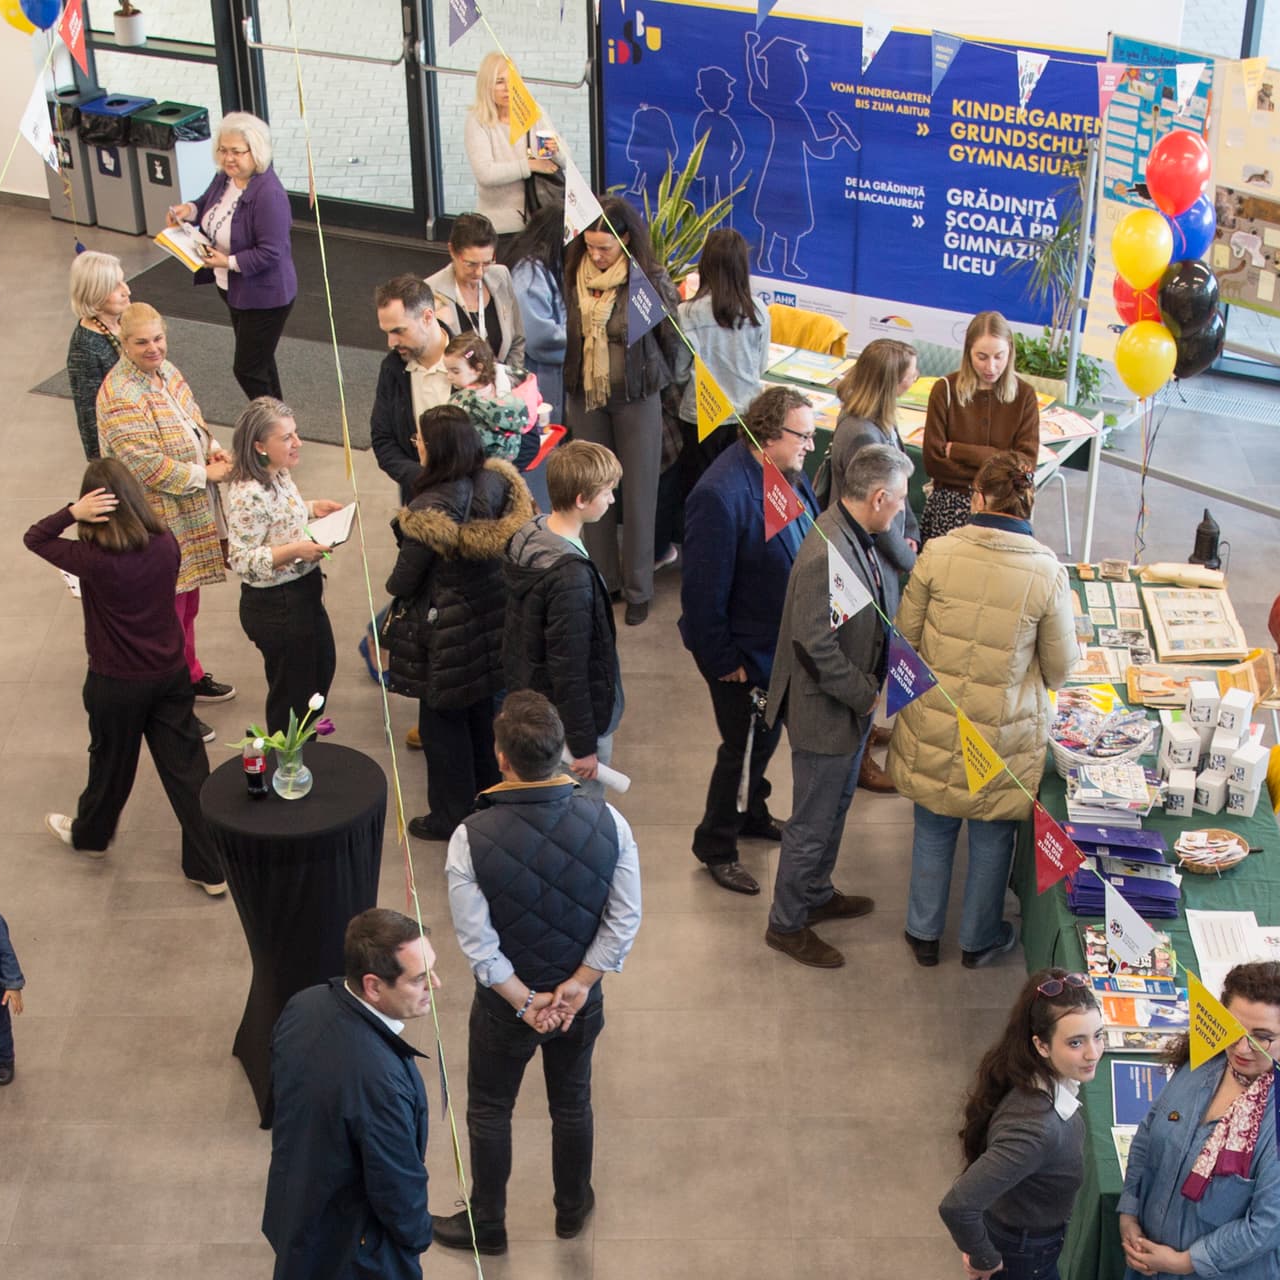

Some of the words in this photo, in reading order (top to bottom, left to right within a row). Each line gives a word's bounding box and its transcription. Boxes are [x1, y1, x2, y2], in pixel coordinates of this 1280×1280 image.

[830, 82, 855, 95] VOM
[856, 86, 931, 105] KINDERGARTEN
[855, 99, 870, 110] BIS
[872, 100, 894, 113] ZUM
[896, 103, 931, 118] ABITUR
[845, 177, 858, 188] DE
[859, 178, 872, 190] LA
[845, 190, 857, 201] LA
[858, 191, 925, 210] BACALAUREAT
[943, 252, 996, 276] LICEU
[776, 293, 796, 307] AHK
[774, 484, 787, 505] STARK
[767, 491, 787, 522] ZUKUNFT
[900, 659, 916, 681] STARK
[890, 666, 915, 698] ZUKUNFT
[1046, 831, 1064, 854] STARK
[1037, 839, 1064, 871] ZUKUNFT
[1195, 1024, 1216, 1049] VIITOR
[1196, 1014, 1222, 1042] PENTRU
